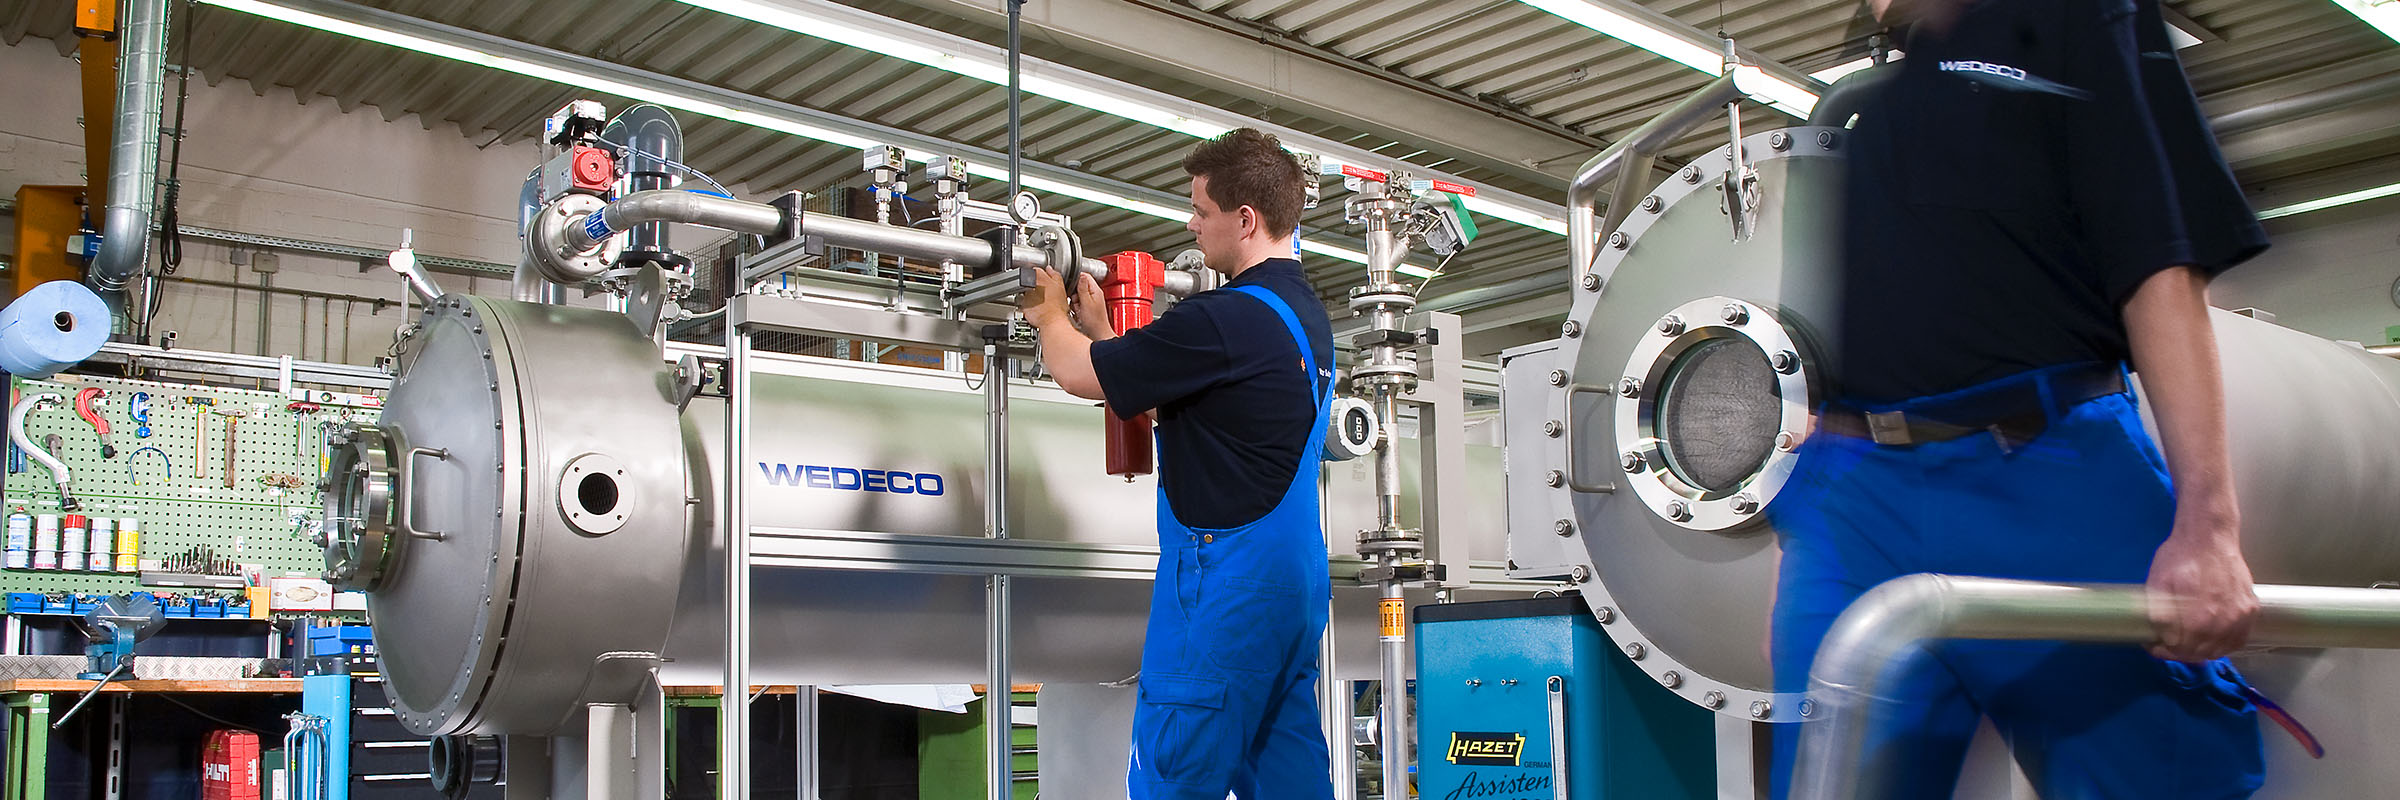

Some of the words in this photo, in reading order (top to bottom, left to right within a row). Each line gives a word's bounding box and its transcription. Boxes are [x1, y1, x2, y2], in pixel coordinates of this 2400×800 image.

[1938, 60, 2026, 81] WEDECO
[758, 461, 944, 496] WEDECO
[1454, 740, 1518, 757] HAZET
[1523, 760, 1552, 769] GERMAN
[1445, 771, 1552, 800] Assisten
